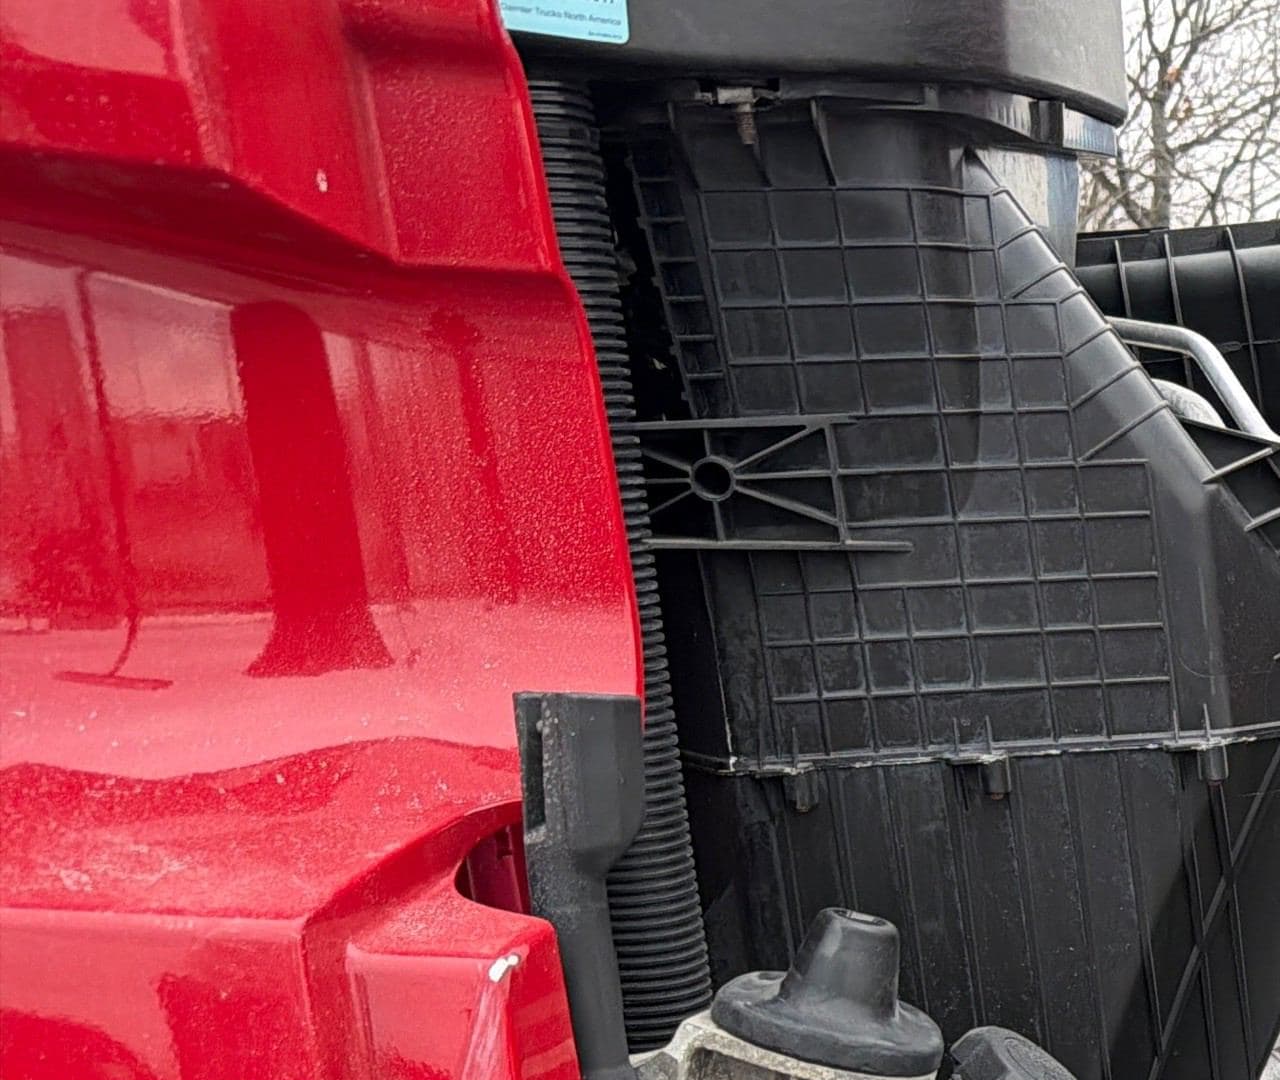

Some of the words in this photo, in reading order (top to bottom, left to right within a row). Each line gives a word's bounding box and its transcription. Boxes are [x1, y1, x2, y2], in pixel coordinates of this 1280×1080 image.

[535, 7, 562, 18] Trucks
[564, 10, 587, 20] North
[588, 14, 621, 26] America
